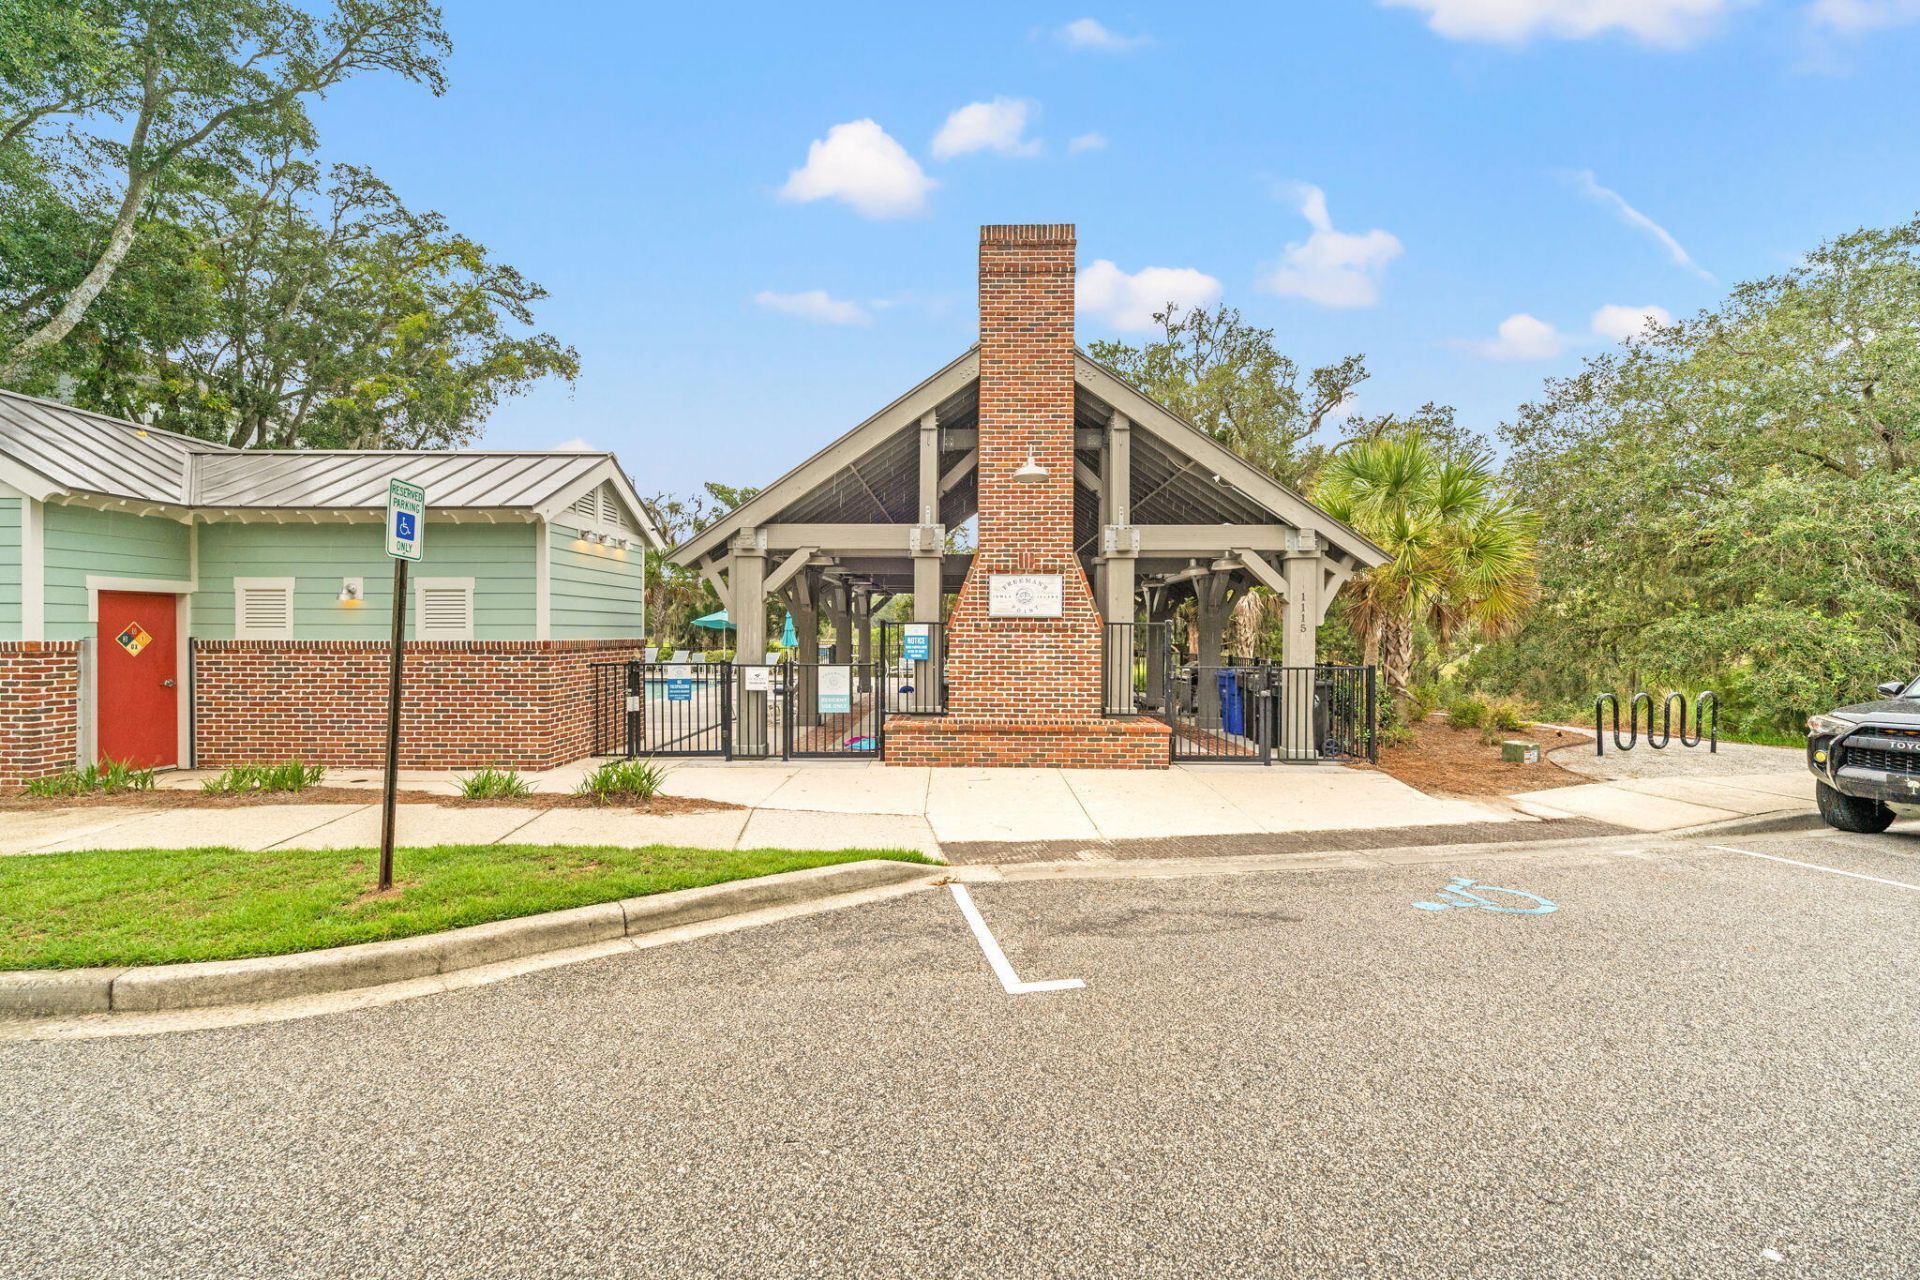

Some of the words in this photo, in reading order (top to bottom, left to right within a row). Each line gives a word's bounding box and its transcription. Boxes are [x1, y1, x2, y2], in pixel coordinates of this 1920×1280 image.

[391, 484, 423, 503] RESERVED
[393, 497, 420, 514] PARKING
[396, 540, 413, 553] ONLY
[907, 636, 926, 645] NOTICE
